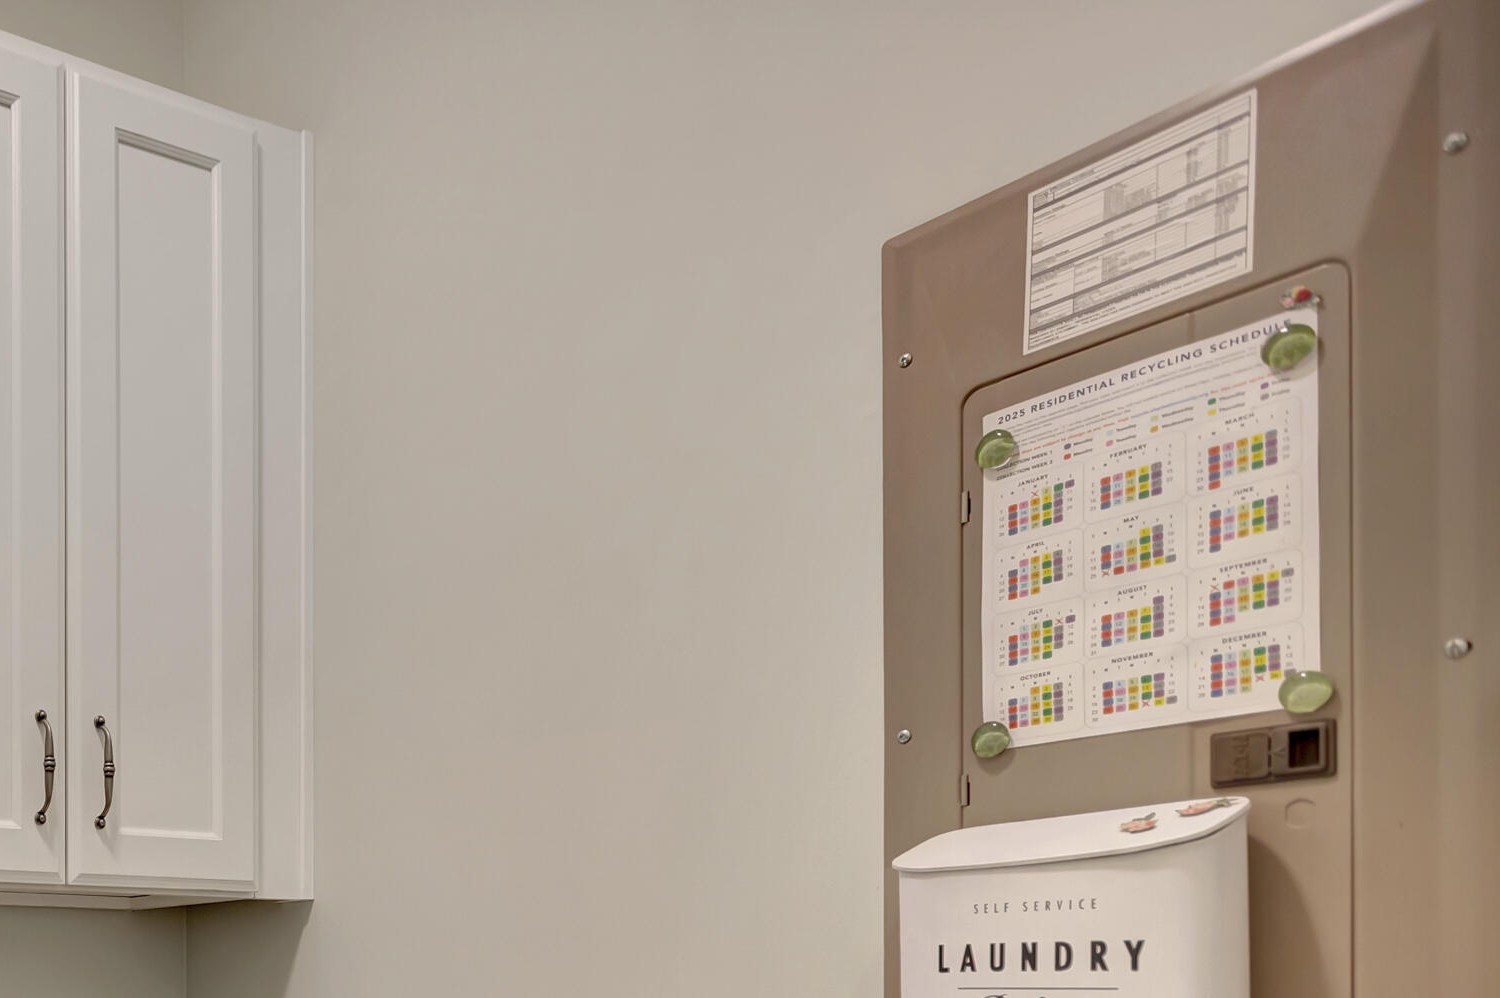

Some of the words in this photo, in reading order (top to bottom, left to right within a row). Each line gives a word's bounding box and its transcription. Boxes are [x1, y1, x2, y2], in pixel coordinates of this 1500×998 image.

[998, 409, 1026, 425] 2025
[1030, 377, 1116, 413] RESIDENTIAL
[1121, 348, 1204, 382] RECYCLING
[1225, 413, 1255, 425] MARCH
[1109, 444, 1147, 459] FEBRUARY
[1018, 474, 1048, 487] JANUARY
[1233, 486, 1254, 497] JUNE
[1123, 515, 1139, 523] MAY
[1026, 541, 1045, 550] APRIL
[1220, 558, 1268, 573] SEPTEMBER
[1117, 585, 1148, 596] AUGUST
[1028, 608, 1043, 616] JULY
[1111, 651, 1154, 664] NOVEMBER
[1020, 671, 1051, 681] OCTOBER
[973, 901, 1009, 914] SELF
[1022, 898, 1098, 912] SERVICE
[938, 939, 1146, 973] LAUNDRY
